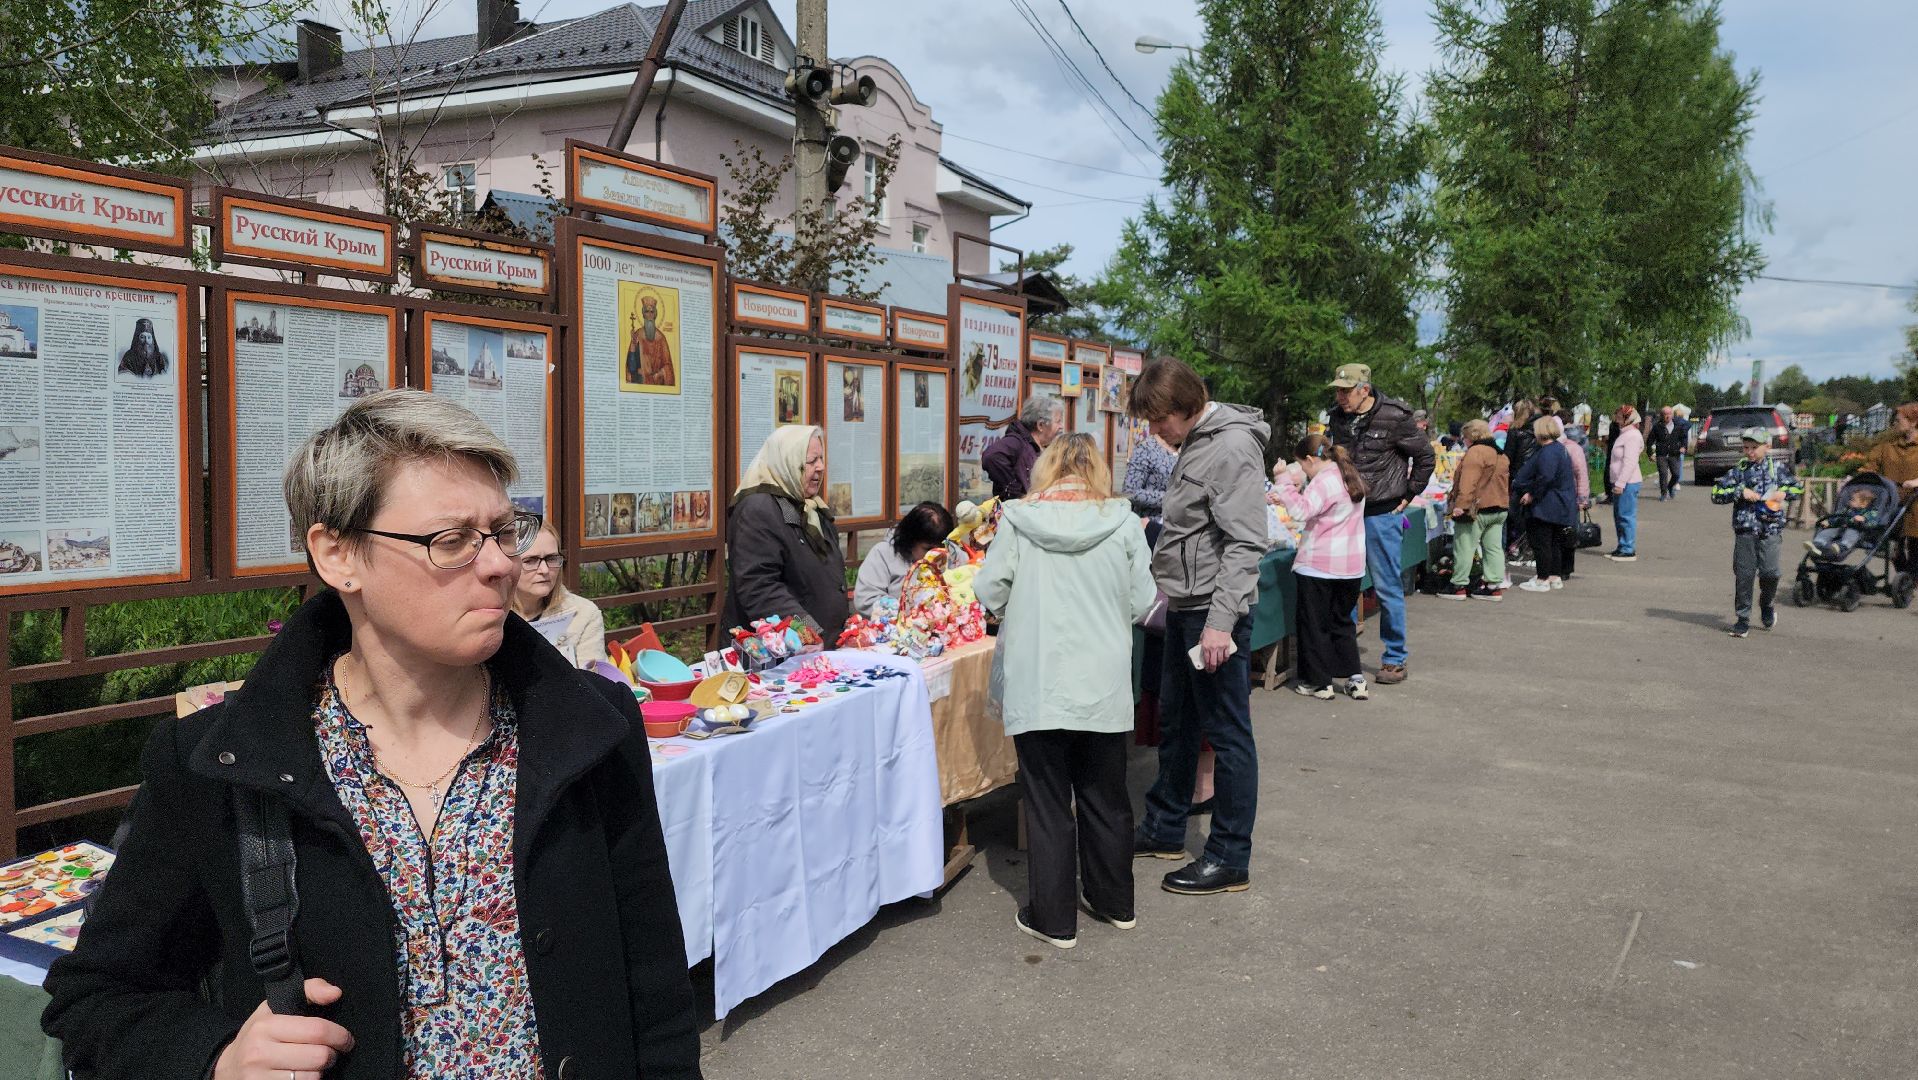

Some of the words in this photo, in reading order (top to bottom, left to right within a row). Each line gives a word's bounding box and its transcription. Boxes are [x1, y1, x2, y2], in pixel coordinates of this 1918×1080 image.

[93, 196, 165, 226] Крым
[235, 215, 318, 247] Русский
[324, 231, 377, 257] Крым
[430, 250, 492, 273] Русский
[497, 260, 538, 280] Крым
[584, 253, 611, 271] 1000
[614, 260, 635, 276] лет
[743, 297, 798, 318] Новороссия
[902, 322, 940, 340] Новороссия
[984, 374, 1016, 390] ВЕЛИКОЙ
